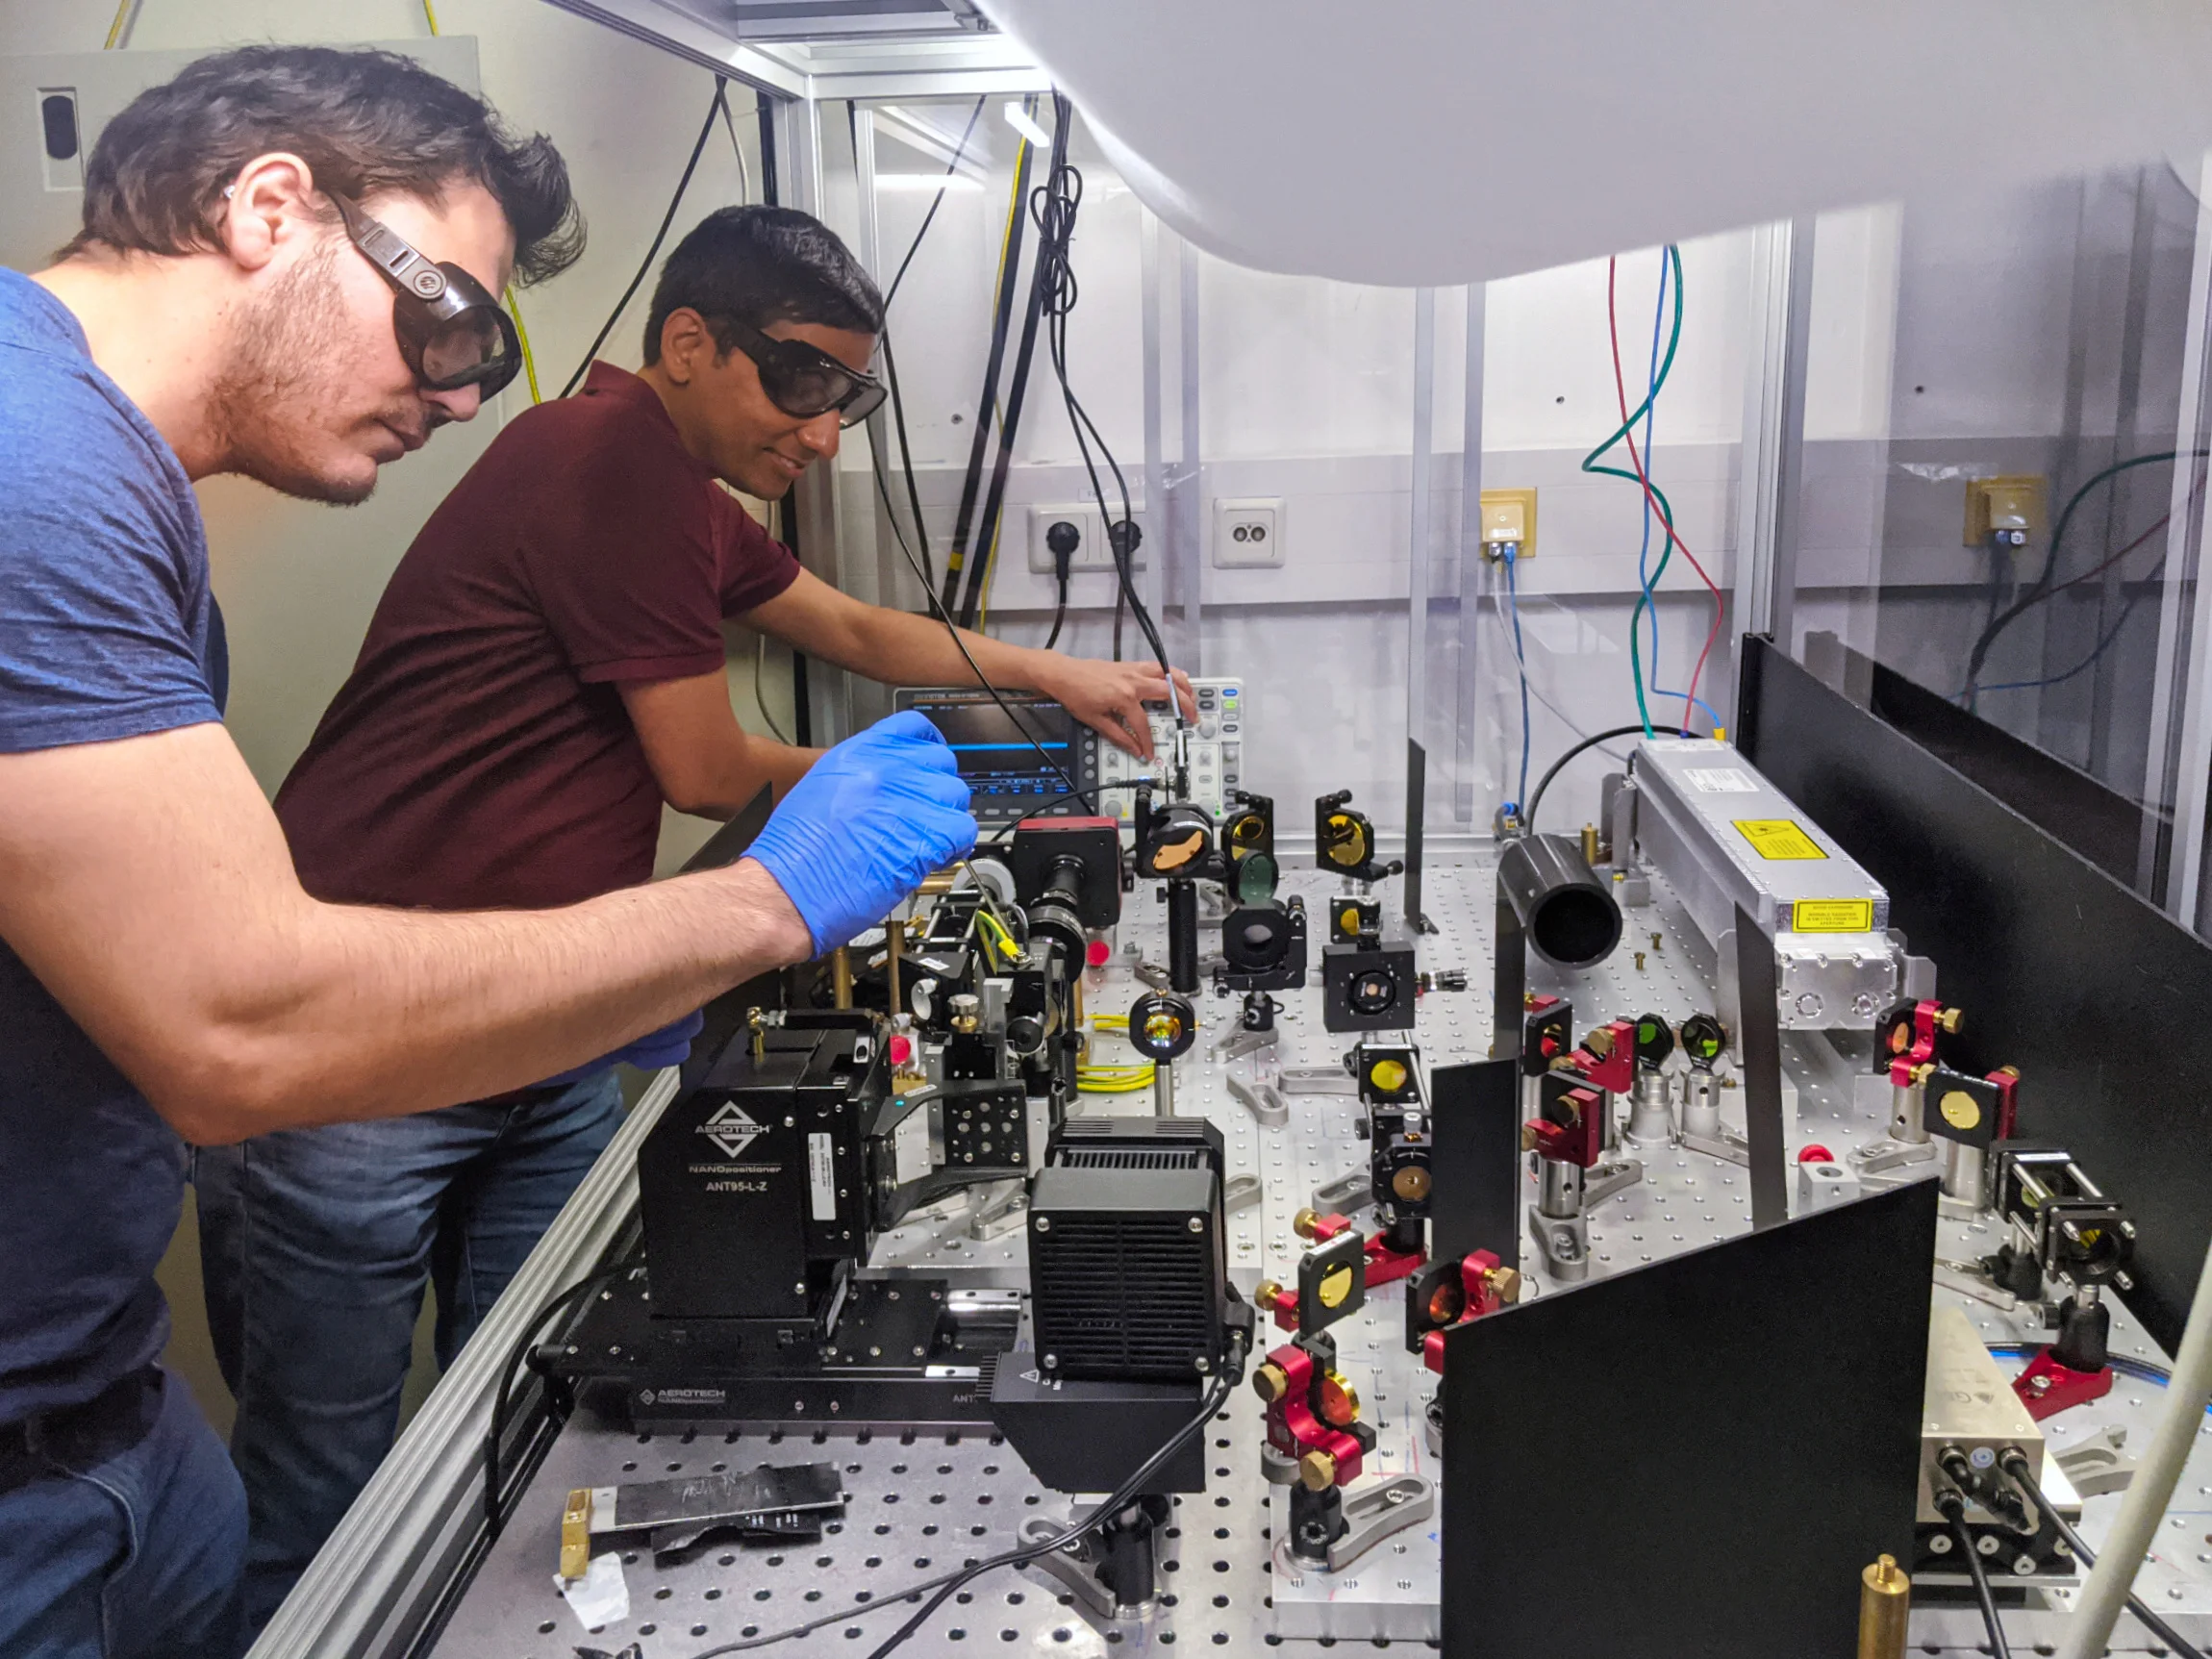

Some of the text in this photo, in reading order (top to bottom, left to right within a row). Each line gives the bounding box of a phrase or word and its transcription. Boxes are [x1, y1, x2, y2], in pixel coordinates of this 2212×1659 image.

[694, 1124, 769, 1134] AEROTECH
[689, 1166, 782, 1174] NANOpositioner
[705, 1181, 768, 1193] ANT95-L-Z
[657, 1389, 726, 1397] AEROTECH
